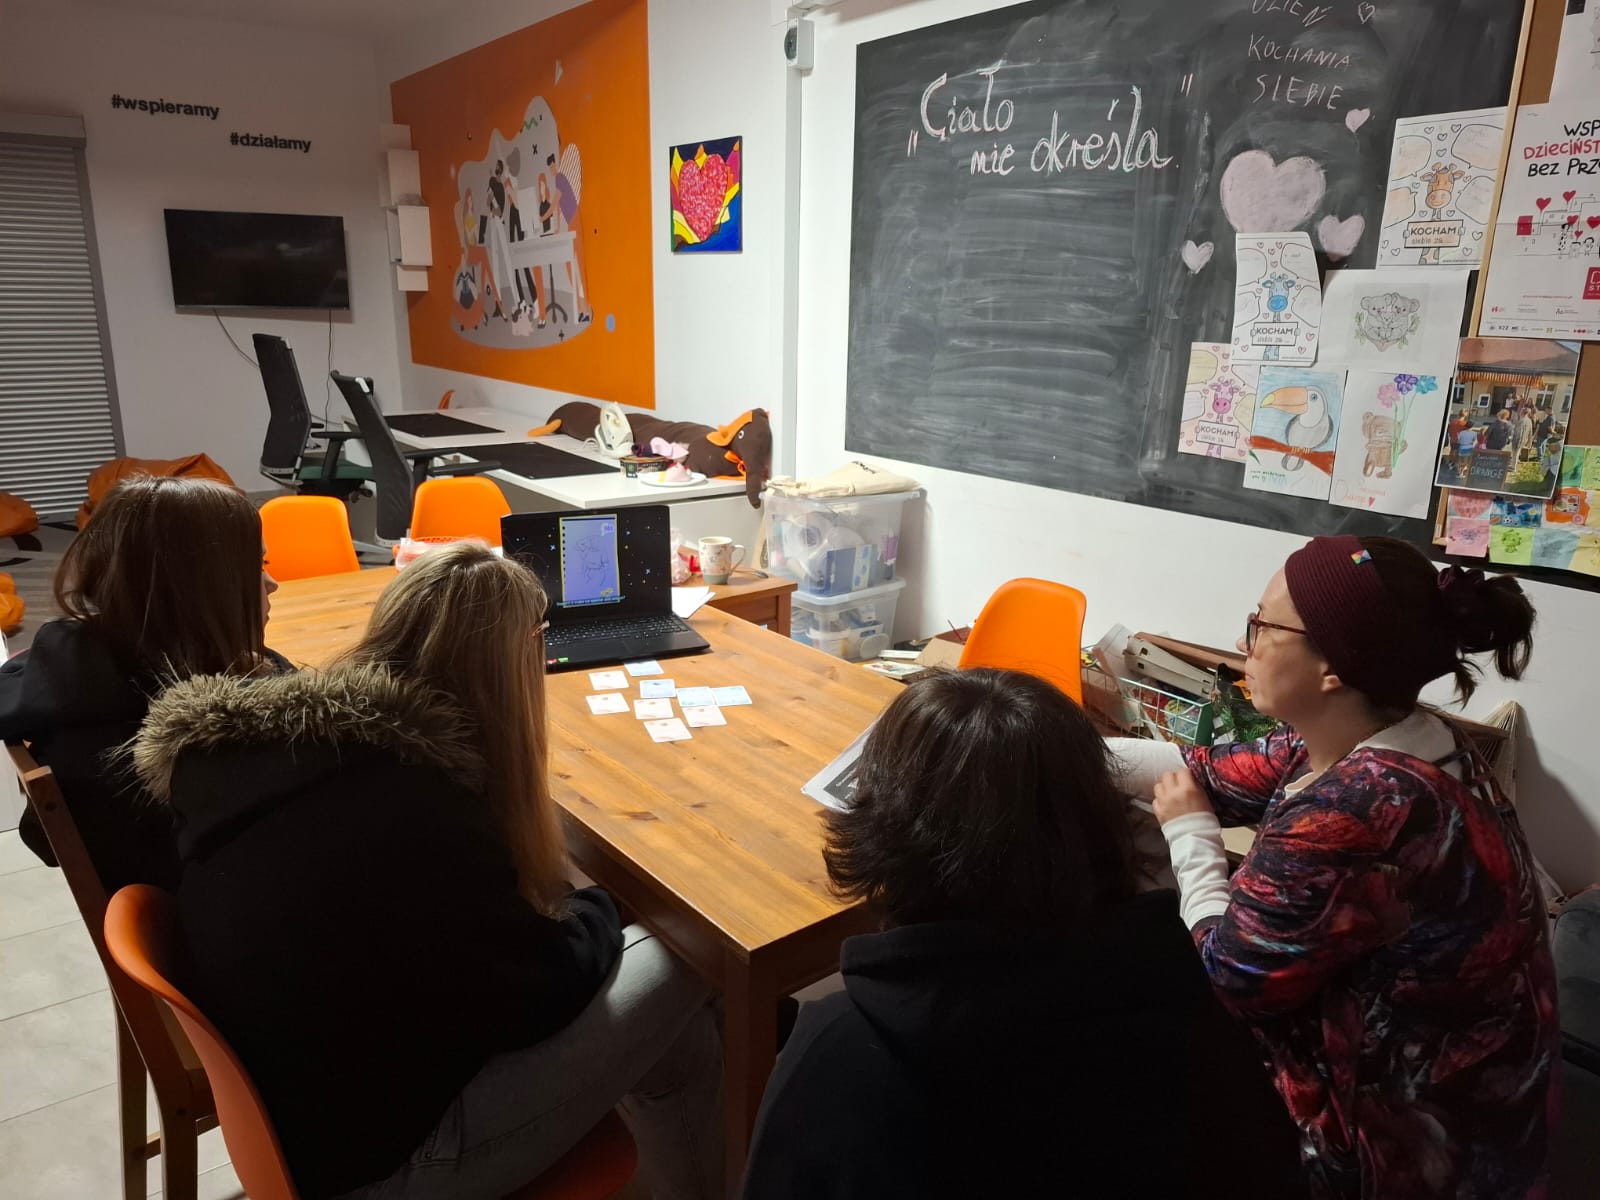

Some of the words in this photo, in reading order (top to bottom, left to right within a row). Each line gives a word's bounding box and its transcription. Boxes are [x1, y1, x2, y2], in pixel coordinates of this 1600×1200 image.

[1248, 32, 1352, 71] KOCHANIA
[1252, 74, 1343, 109] SIEBIE
[111, 94, 219, 120] #wspieramy
[230, 132, 312, 153] #działamy
[970, 142, 1015, 175] nie
[1410, 226, 1457, 235] KOCHAM
[1256, 327, 1293, 335] KOCHAM
[1200, 425, 1234, 437] KOCHAM
